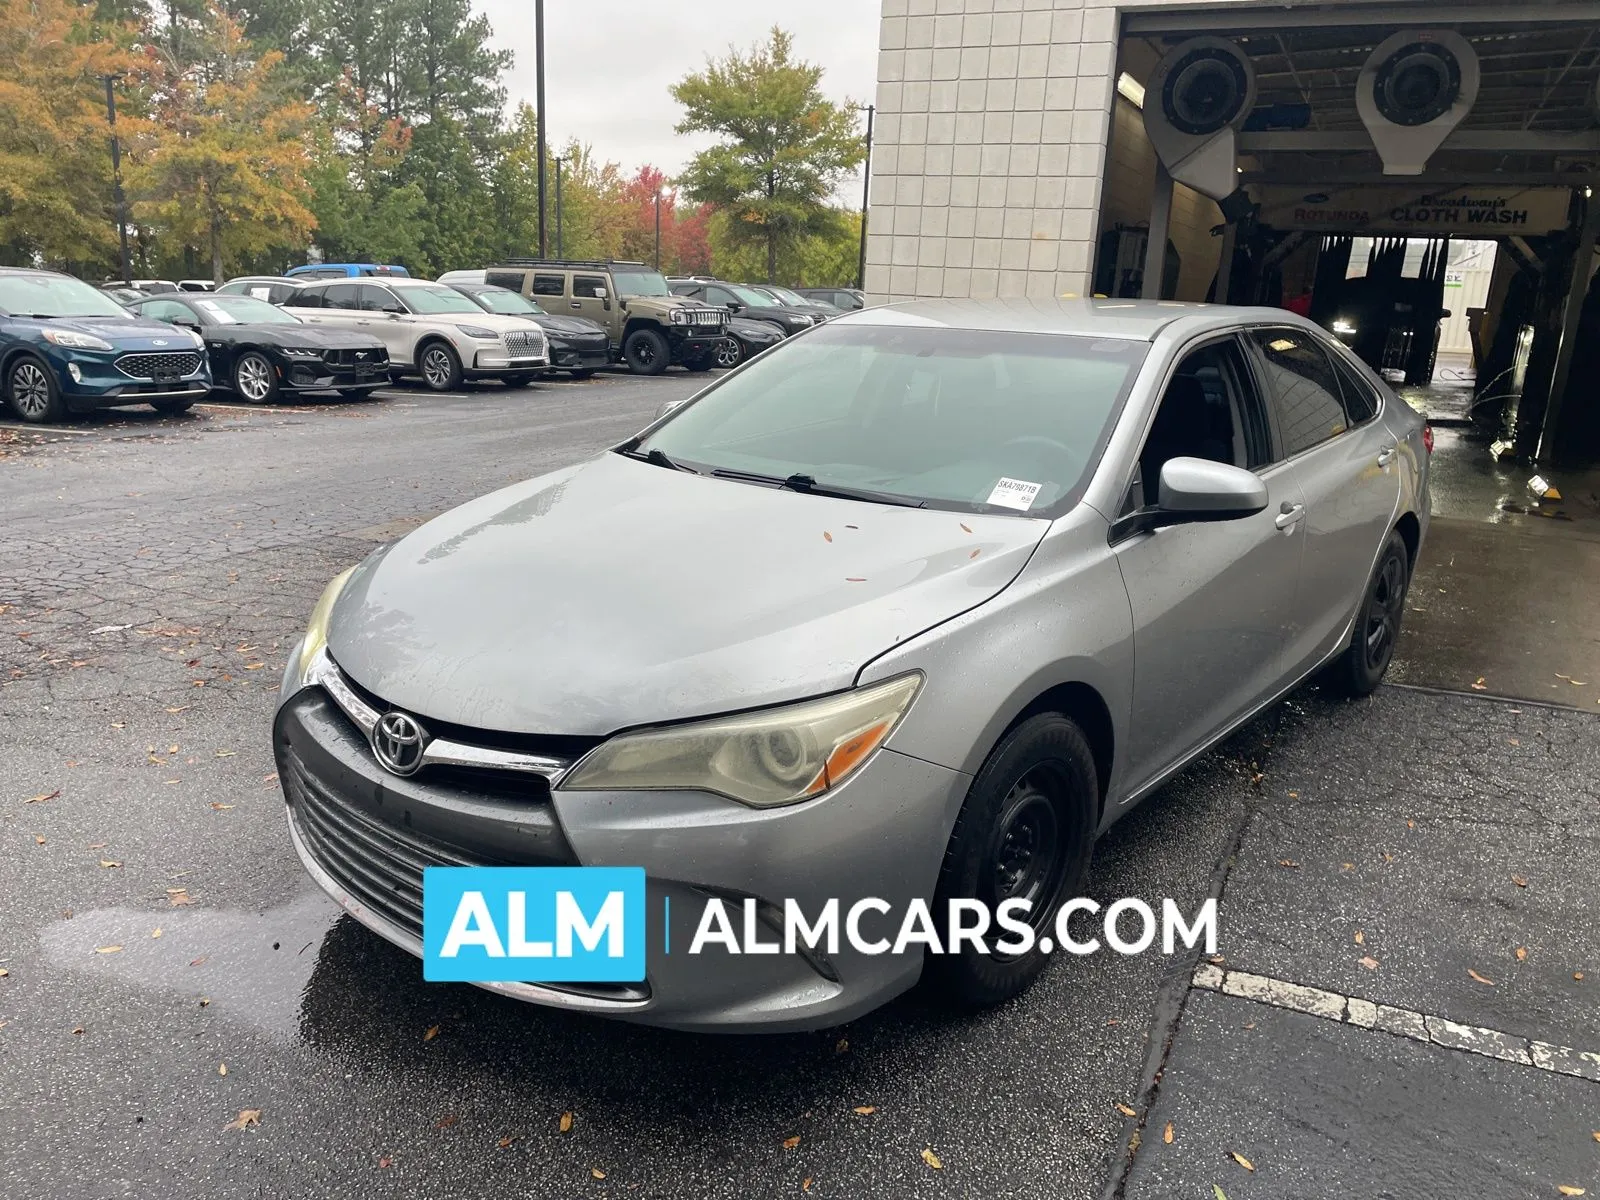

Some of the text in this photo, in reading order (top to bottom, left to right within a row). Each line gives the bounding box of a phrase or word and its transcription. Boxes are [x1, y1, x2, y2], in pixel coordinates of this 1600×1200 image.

[1294, 208, 1370, 222] ROTUNDA
[1389, 208, 1527, 224] CLOTH WASH
